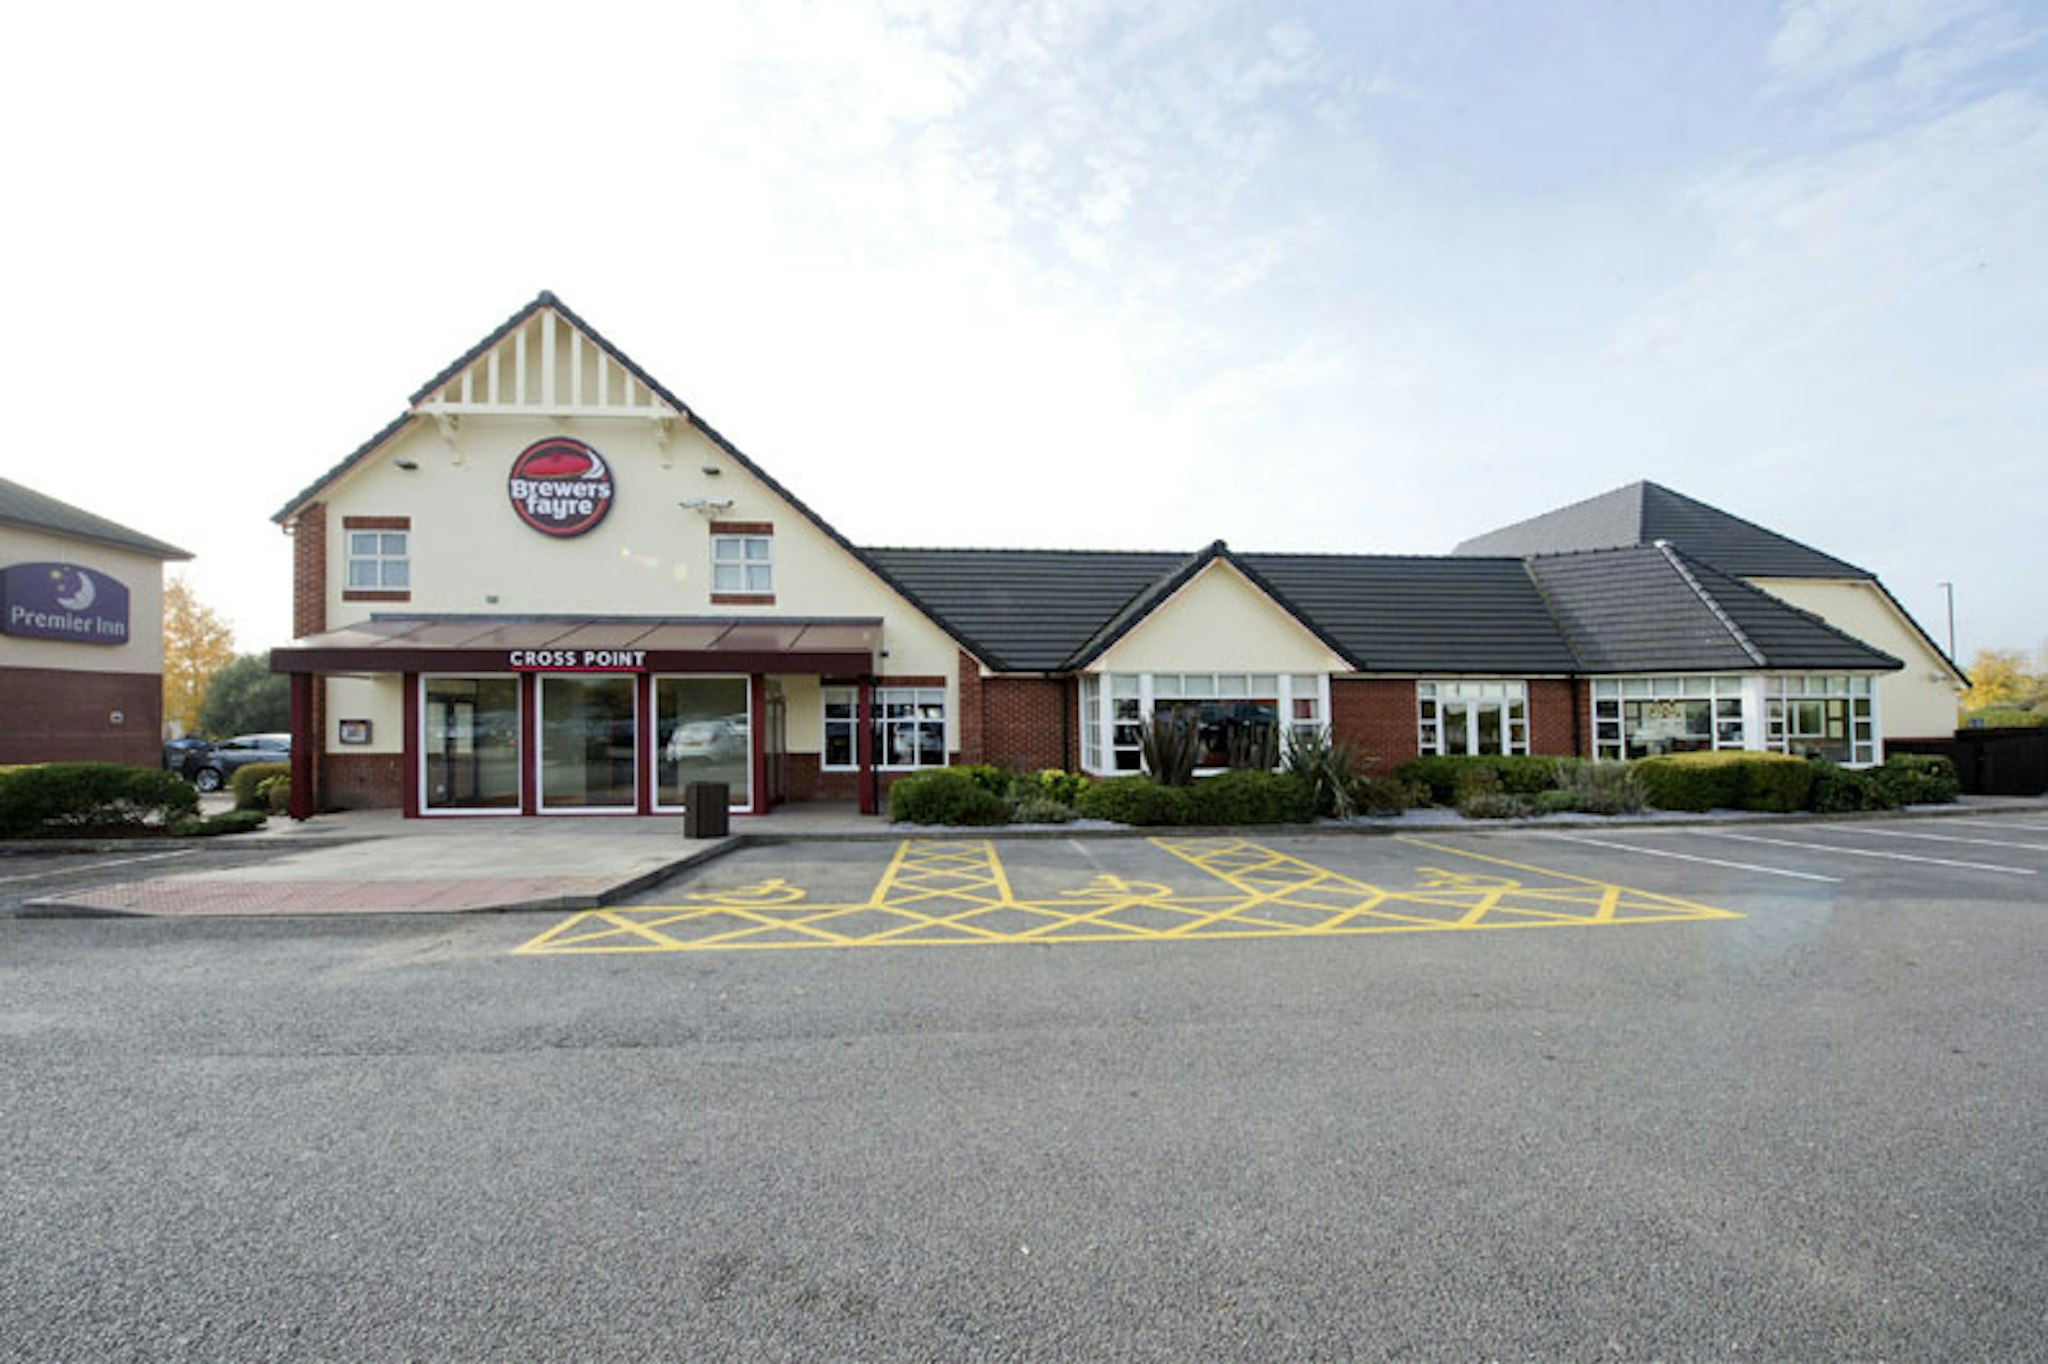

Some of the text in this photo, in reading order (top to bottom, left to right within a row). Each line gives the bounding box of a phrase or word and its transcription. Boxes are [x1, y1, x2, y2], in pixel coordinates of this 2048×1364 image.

[511, 479, 611, 499] Brewers
[11, 605, 125, 635] Premier Inn
[510, 651, 646, 666] CROSS POINT
